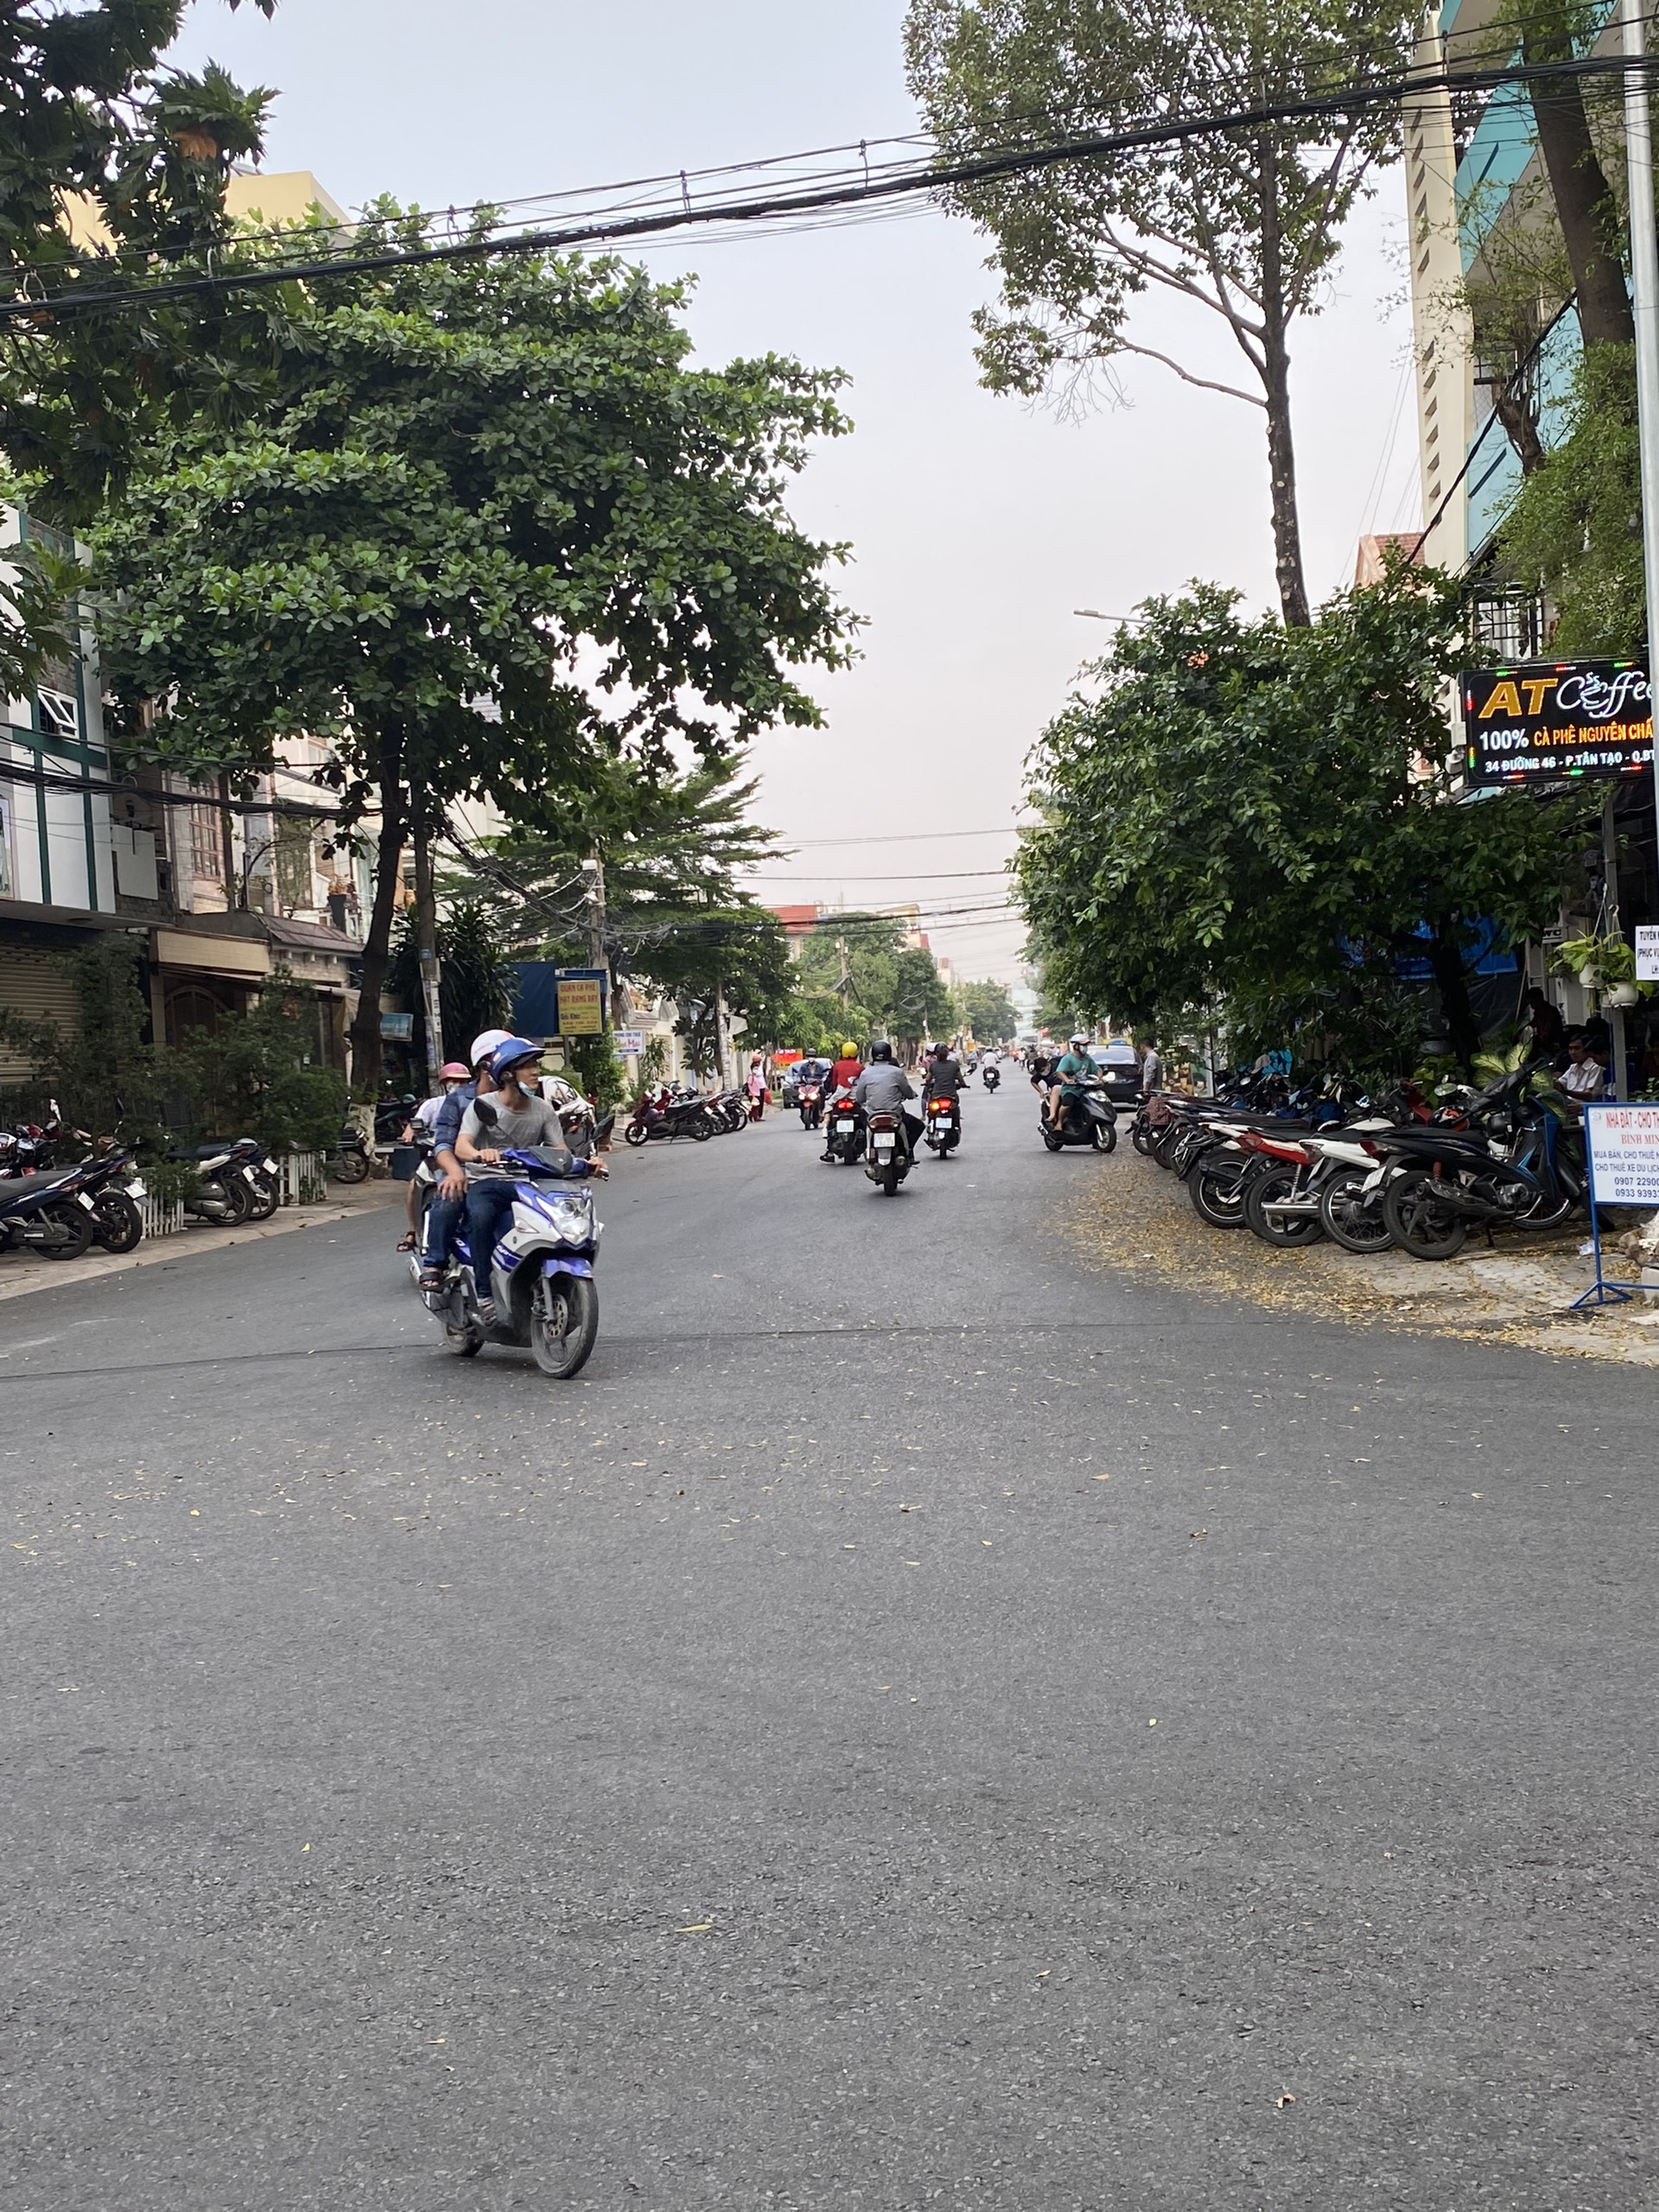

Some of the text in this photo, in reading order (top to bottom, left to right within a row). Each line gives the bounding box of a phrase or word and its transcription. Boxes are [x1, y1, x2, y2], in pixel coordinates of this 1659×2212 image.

[1478, 678, 1559, 719] AT
[1479, 728, 1529, 751] 100%
[1553, 724, 1576, 745] PHÊ
[1579, 721, 1626, 743] NGUYÊN
[1485, 760, 1500, 773] 34
[1541, 756, 1556, 769] 46
[1566, 751, 1598, 766] P.TÂN
[1599, 752, 1623, 766] TẠO
[1638, 1111, 1651, 1128] CHO
[1624, 1150, 1637, 1160] CHO
[1595, 1163, 1609, 1172] CHO
[1627, 1164, 1636, 1173] XE
[1637, 1164, 1646, 1173] DU
[1614, 1177, 1633, 1185] 0907
[1616, 1188, 1635, 1198] 0933
